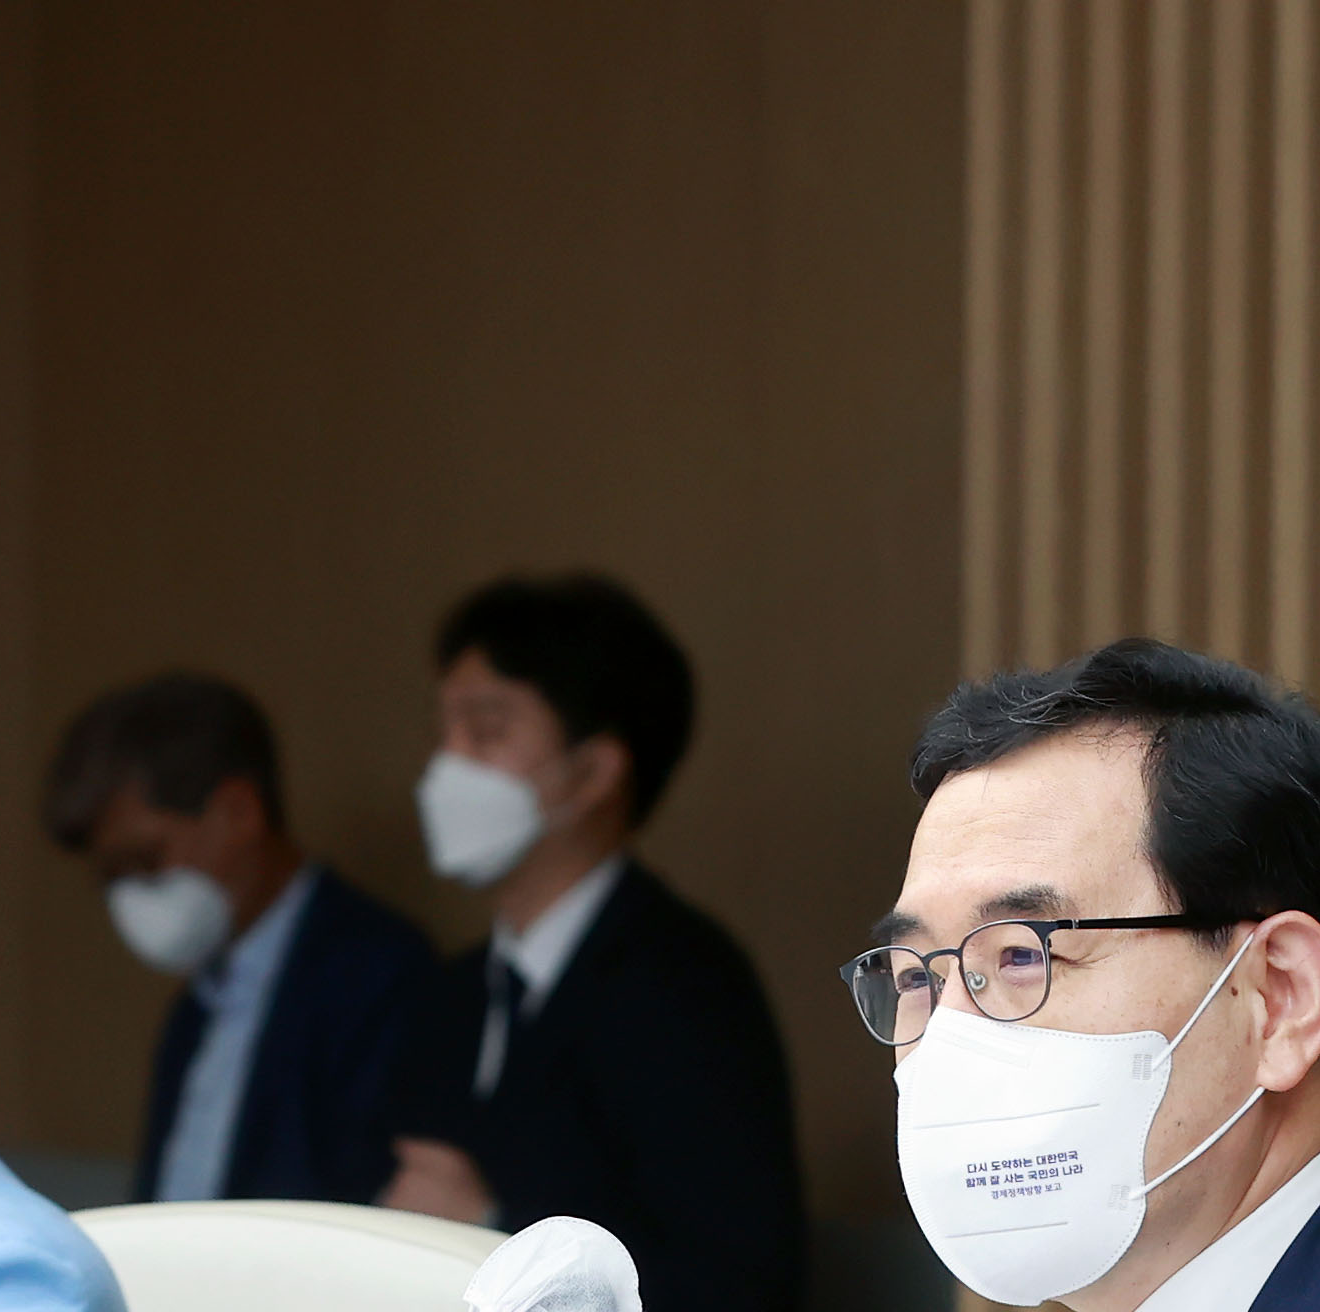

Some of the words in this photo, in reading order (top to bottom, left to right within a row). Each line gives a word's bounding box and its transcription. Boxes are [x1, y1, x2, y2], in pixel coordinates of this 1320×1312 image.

[967, 1163, 987, 1174] 다시
[991, 1158, 1033, 1171] 도약하는
[1036, 1150, 1078, 1165] 대한민국
[966, 1176, 986, 1188] 함께
[990, 1175, 1000, 1186] 잘
[1003, 1173, 1024, 1184] 사는
[1028, 1167, 1059, 1180] 국민의
[1062, 1164, 1083, 1176] 나라
[1044, 1183, 1062, 1192] 보고
